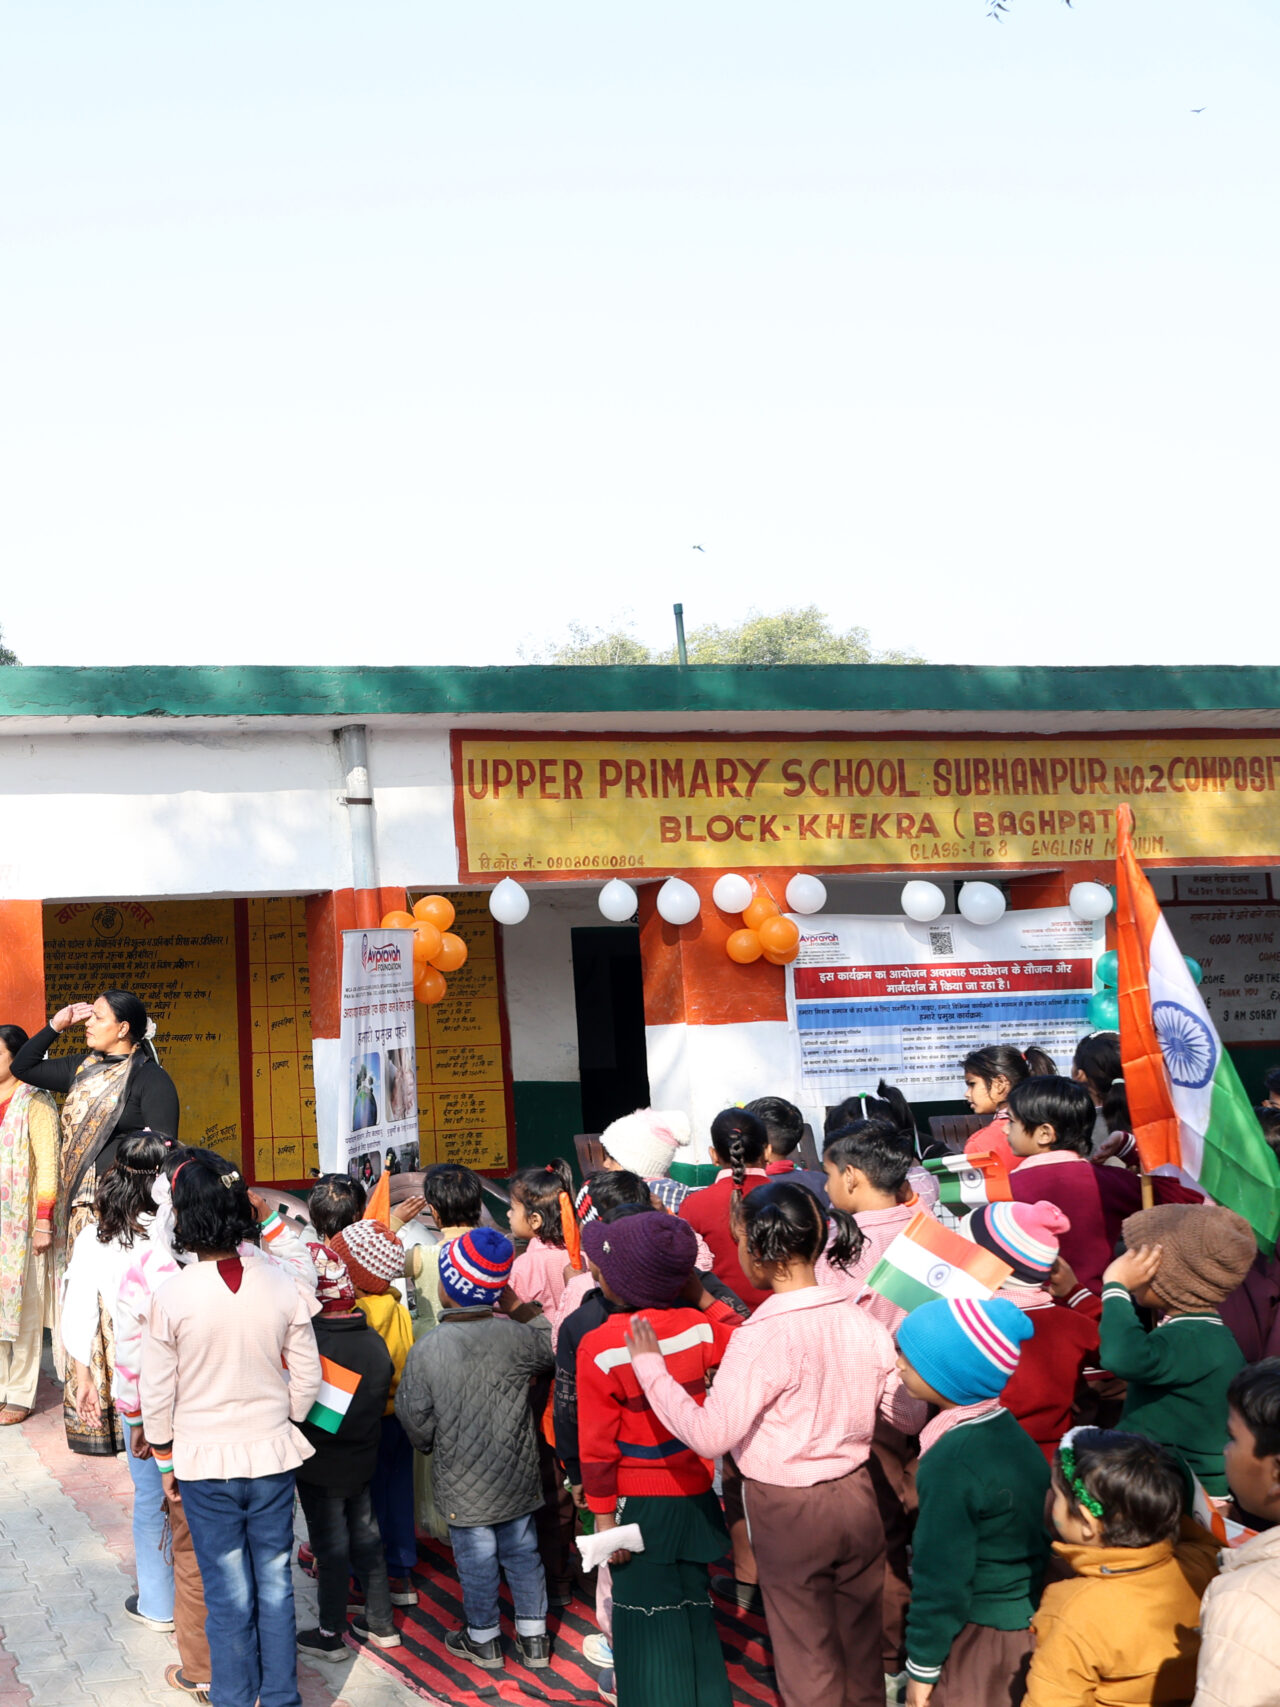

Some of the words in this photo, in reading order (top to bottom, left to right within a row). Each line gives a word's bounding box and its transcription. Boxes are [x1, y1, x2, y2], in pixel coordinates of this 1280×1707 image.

[467, 758, 583, 800] UPPER
[599, 758, 770, 799] PRIMARY
[781, 758, 921, 798] SCHOOL
[932, 757, 1111, 796] SUBHANPUR
[1031, 838, 1094, 857] ENGLISH
[819, 972, 834, 983] इस
[838, 968, 872, 980] कार्यक्रम
[874, 971, 887, 979] का
[890, 966, 927, 979] आयोजन
[930, 967, 967, 978] अवप्रवाह
[969, 964, 1008, 976] फाउंडेशन
[1011, 963, 1020, 974] के
[1023, 962, 1052, 974] सौजन्य
[1055, 961, 1072, 973] और
[886, 980, 926, 993] मार्गदर्शन
[928, 980, 937, 991] में
[940, 979, 963, 991] किया
[965, 981, 978, 991] जा
[980, 980, 996, 990] रहा
